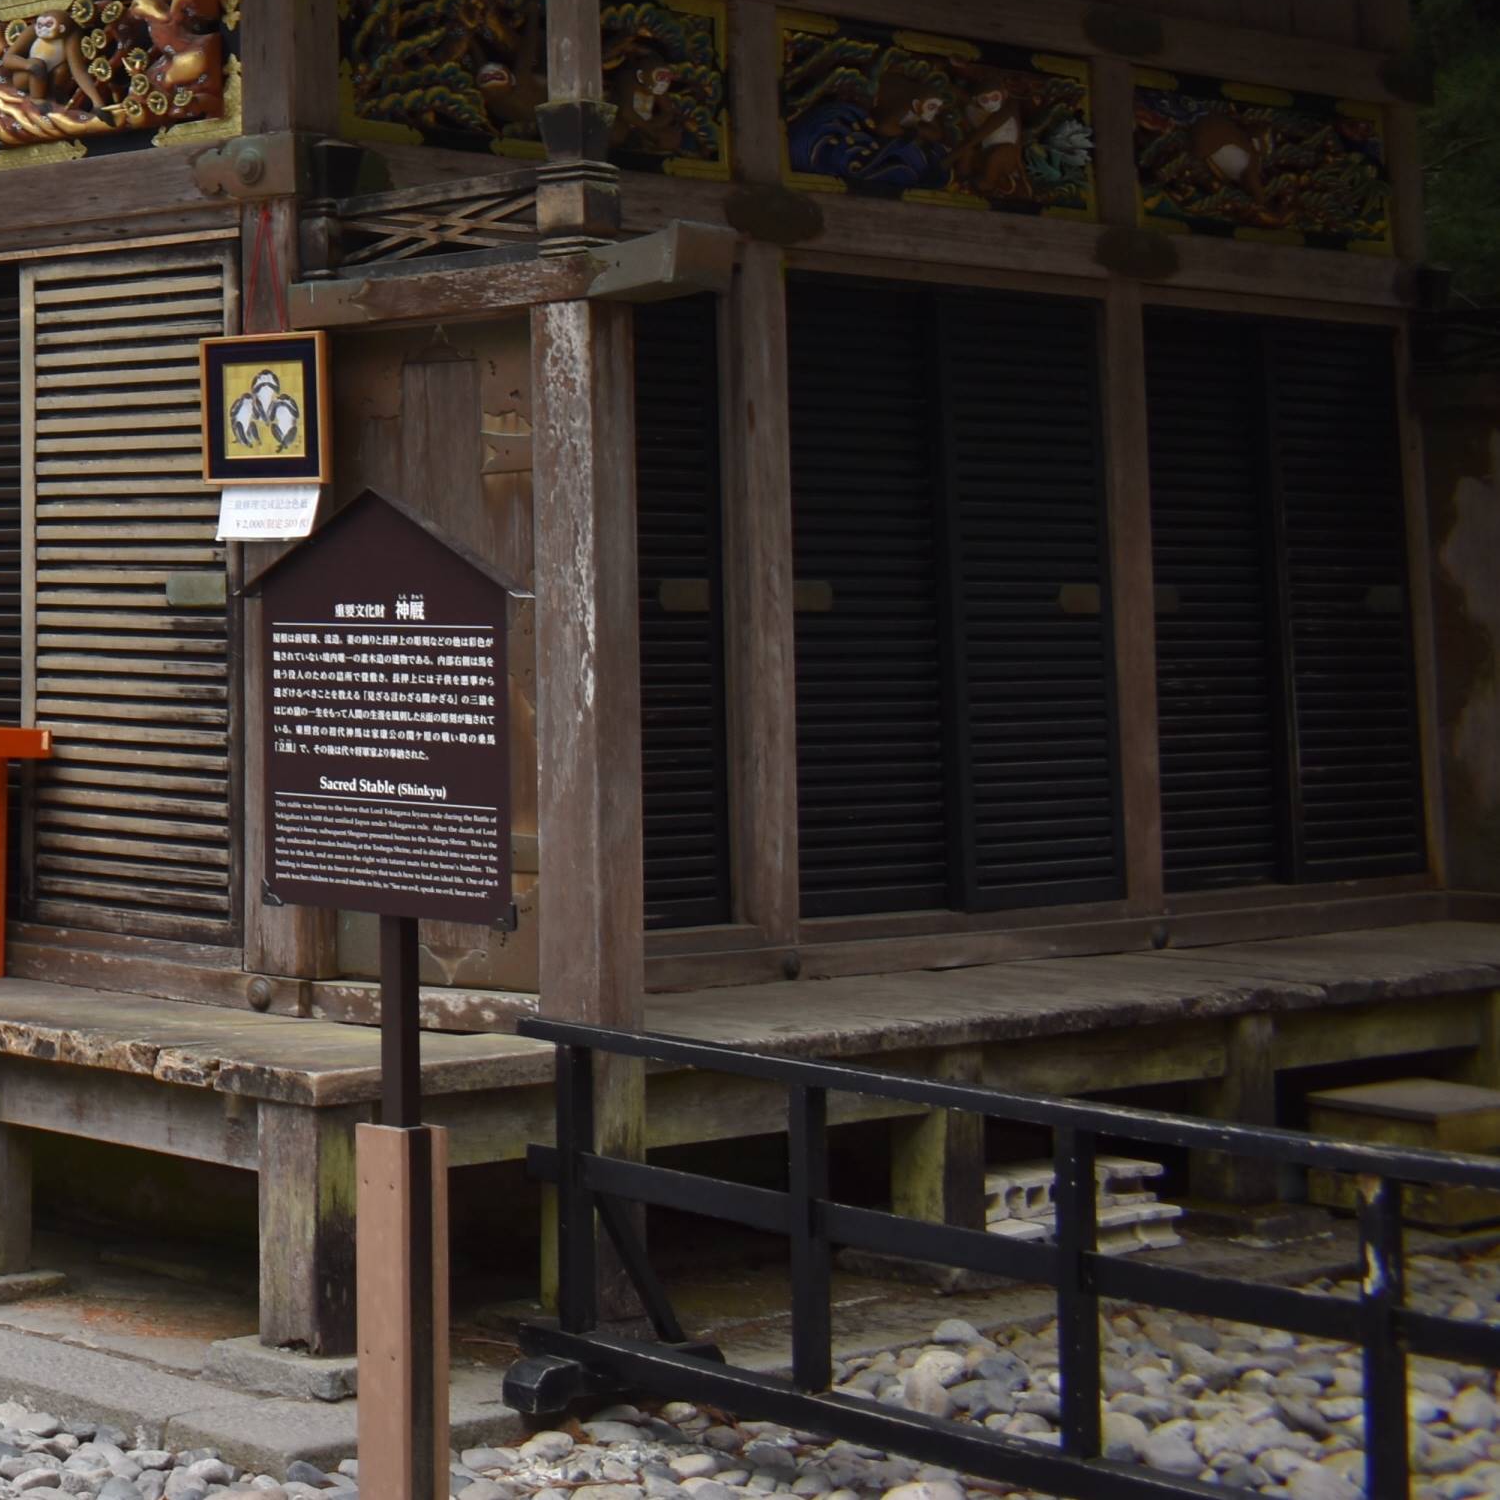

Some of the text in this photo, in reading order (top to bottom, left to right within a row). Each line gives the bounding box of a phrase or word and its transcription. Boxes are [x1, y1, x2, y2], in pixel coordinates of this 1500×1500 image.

[334, 604, 386, 618] 重要文化財
[320, 776, 447, 800] Sacred Stable (Shinkyu)
